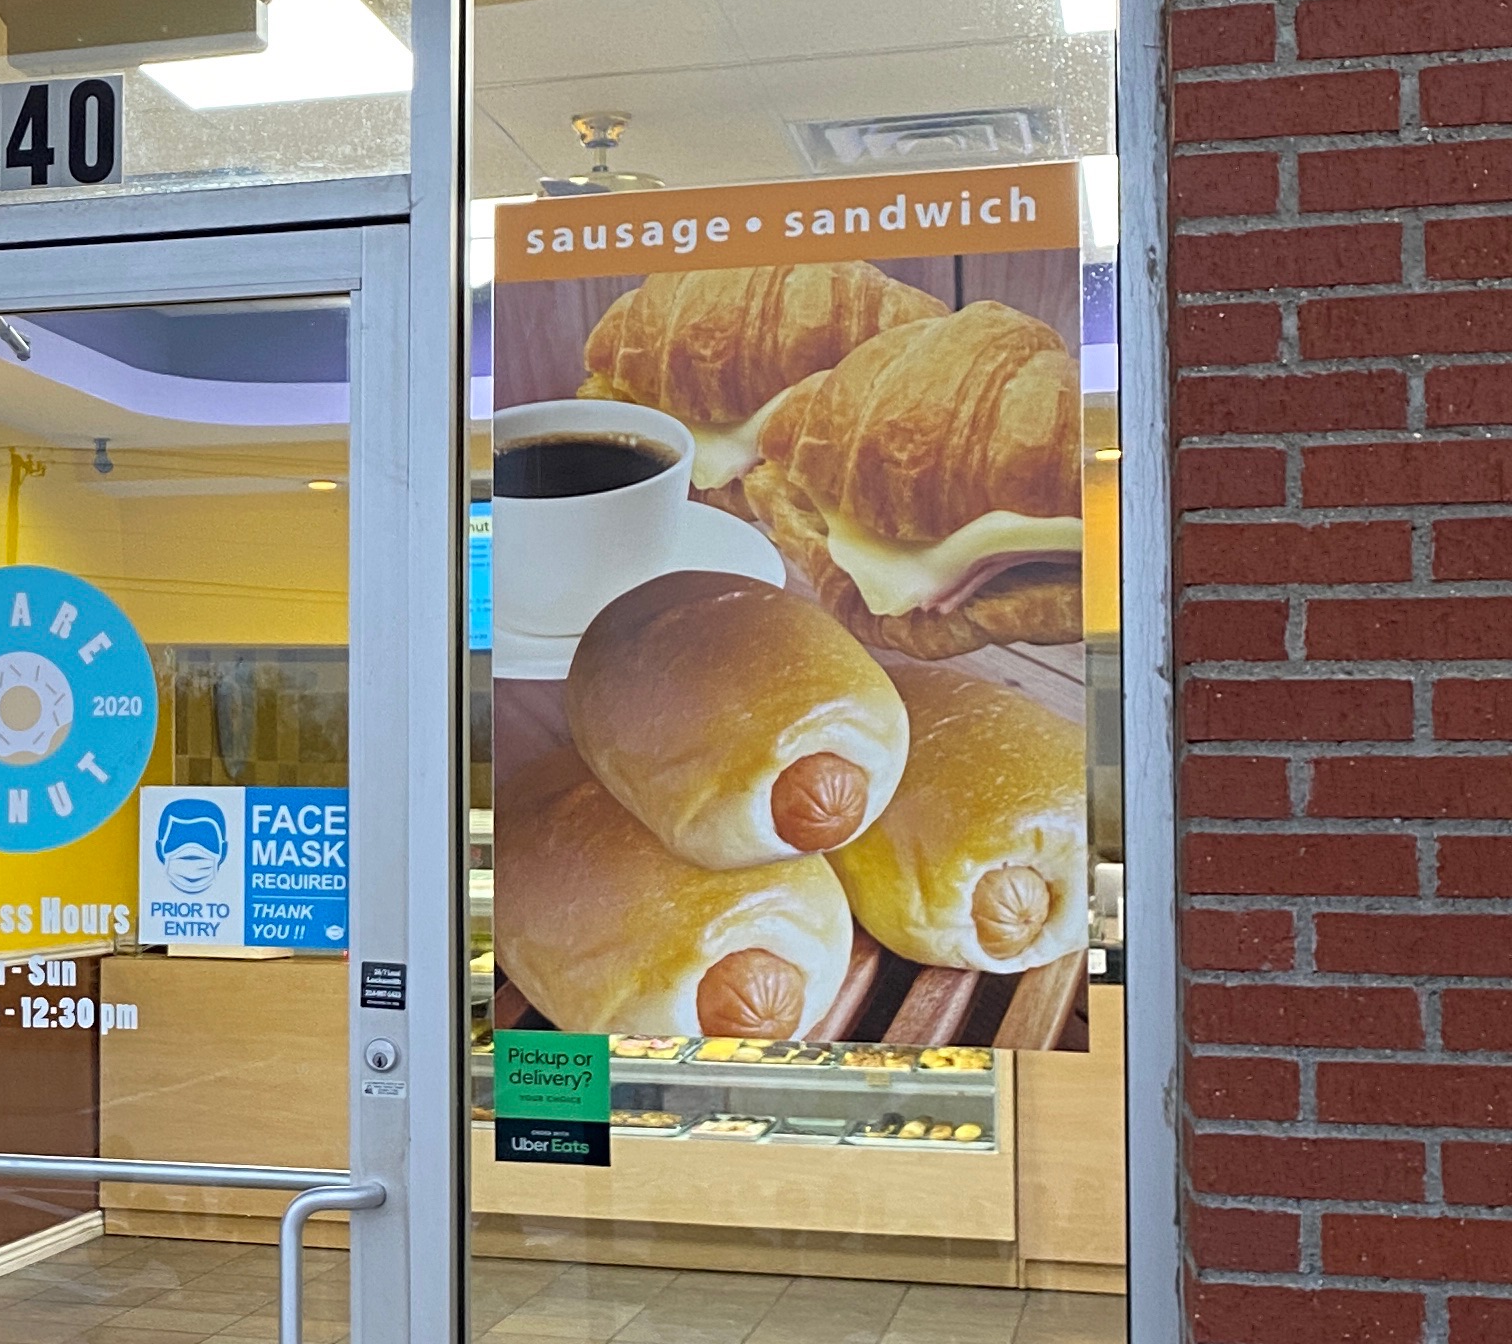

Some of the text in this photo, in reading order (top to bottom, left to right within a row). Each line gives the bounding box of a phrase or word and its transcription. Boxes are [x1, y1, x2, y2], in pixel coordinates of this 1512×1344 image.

[526, 186, 1038, 254] sausage sandwich
[92, 695, 143, 717] 2020
[251, 804, 347, 836] FACE
[251, 839, 346, 868] MASK
[251, 873, 347, 891] REQUIRED
[40, 896, 131, 935] Hours
[150, 902, 230, 919] PRIOR TO
[251, 903, 315, 920] THANK
[164, 921, 221, 937] ENTRY
[251, 924, 290, 939] YOU
[27, 955, 77, 987] Sun
[20, 996, 95, 1029] 12:30
[101, 1002, 139, 1035] pm
[508, 1047, 593, 1069] Pickup or
[508, 1069, 593, 1091] delivery?
[511, 1136, 590, 1155] Uber Eats
